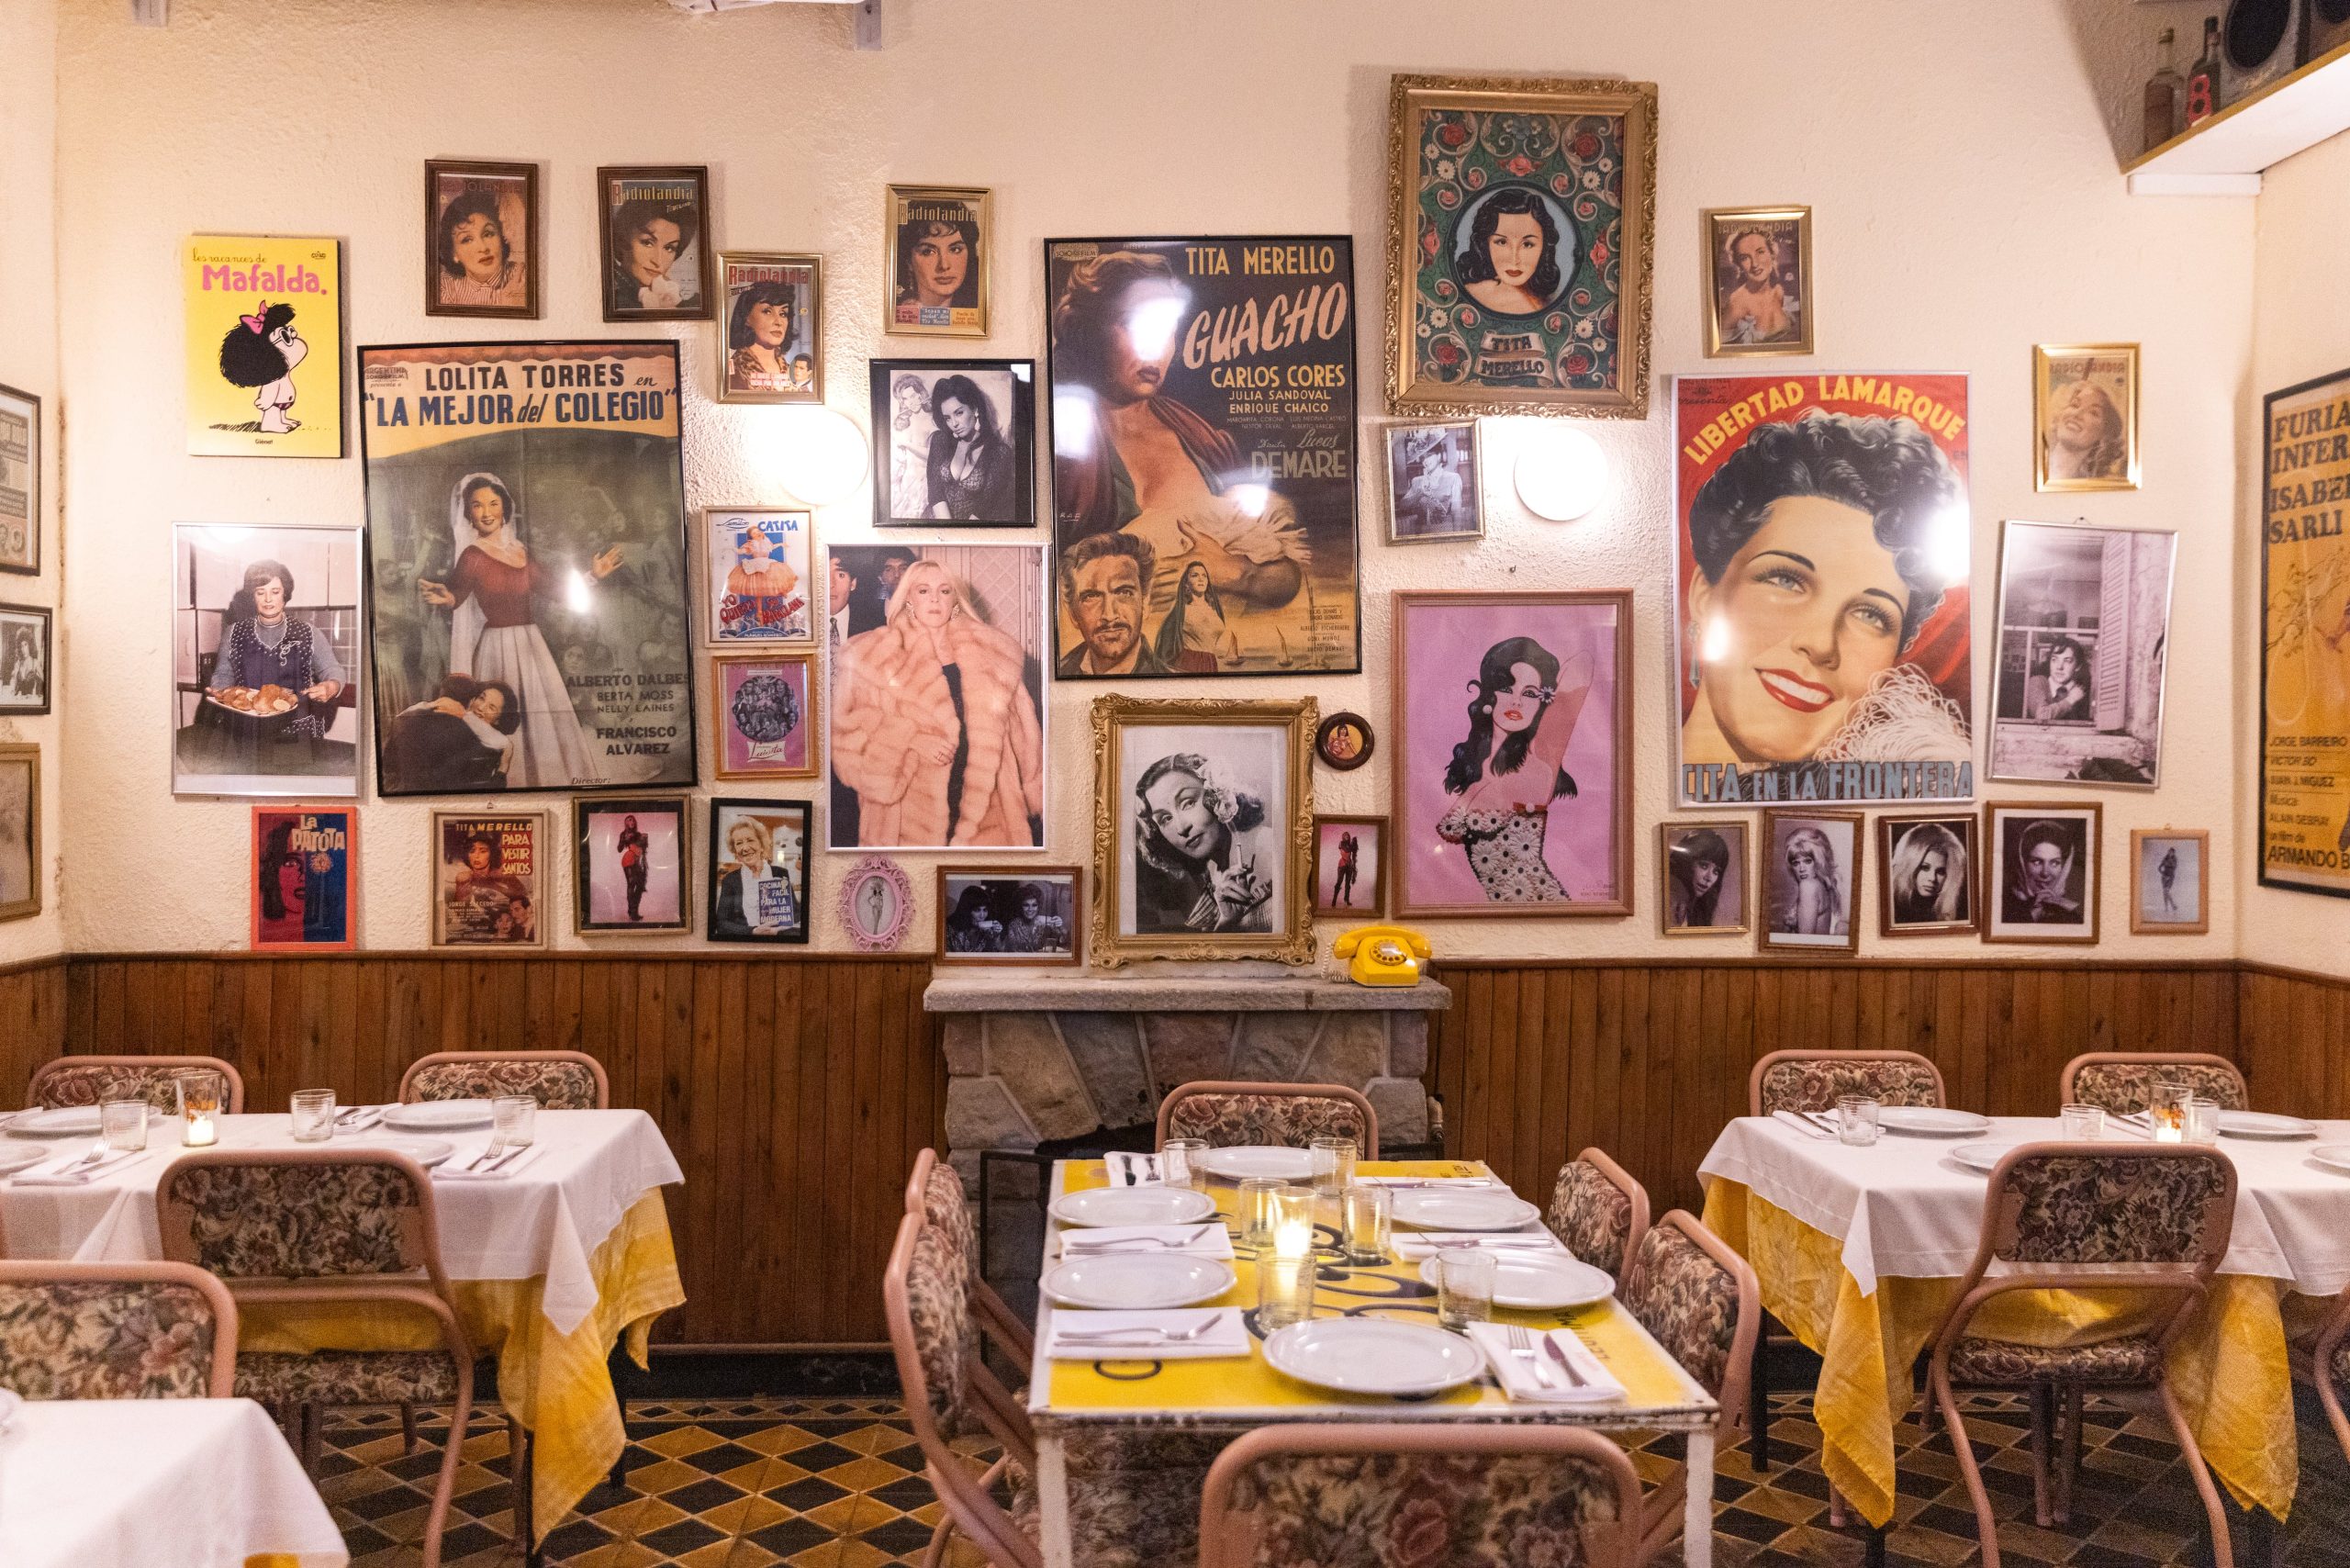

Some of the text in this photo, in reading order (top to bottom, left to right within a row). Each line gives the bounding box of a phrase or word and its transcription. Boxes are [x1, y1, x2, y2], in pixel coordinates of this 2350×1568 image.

[611, 185, 693, 205] Radiolandia
[898, 203, 977, 224] Radiolandia
[193, 247, 267, 263] les vacances de
[1184, 246, 1336, 275] TITA MERELLO
[728, 265, 809, 286] Radiolandia
[1182, 281, 1348, 369] GUACHO
[1480, 335, 1545, 375] TITA MERELLO
[426, 363, 658, 391] LOLITA TORRES en
[1211, 364, 1346, 387] CARLOS CORES
[1229, 389, 1332, 400] JULIA SANDOVAL
[364, 387, 677, 427] "LA MEJOR del COLEGIO"
[1230, 402, 1329, 414] ENRIQUE CHAICO
[1684, 375, 1966, 465] LIBERTAD LAMARQUE
[2274, 400, 2350, 443] FURIA
[1296, 429, 1341, 449] Lucas
[1250, 449, 1348, 478] DEMARE
[757, 520, 799, 532] CATITA
[2268, 509, 2343, 544] SARLI
[565, 674, 632, 688] ALBERTO
[598, 690, 674, 702] BERTA MOSS
[597, 704, 631, 713] NELLY
[597, 726, 677, 739] FRANCISCO
[606, 743, 670, 756] ALVAREZ
[1682, 760, 1974, 803] CITA EN LA FRONTERA
[300, 814, 318, 829] La
[476, 823, 532, 832] MERELLO
[291, 828, 346, 852] PATOTA
[502, 834, 531, 846] PARA
[501, 847, 531, 859] VESTIR
[2266, 845, 2338, 868] ARMANDO
[501, 862, 532, 875] SANTOS
